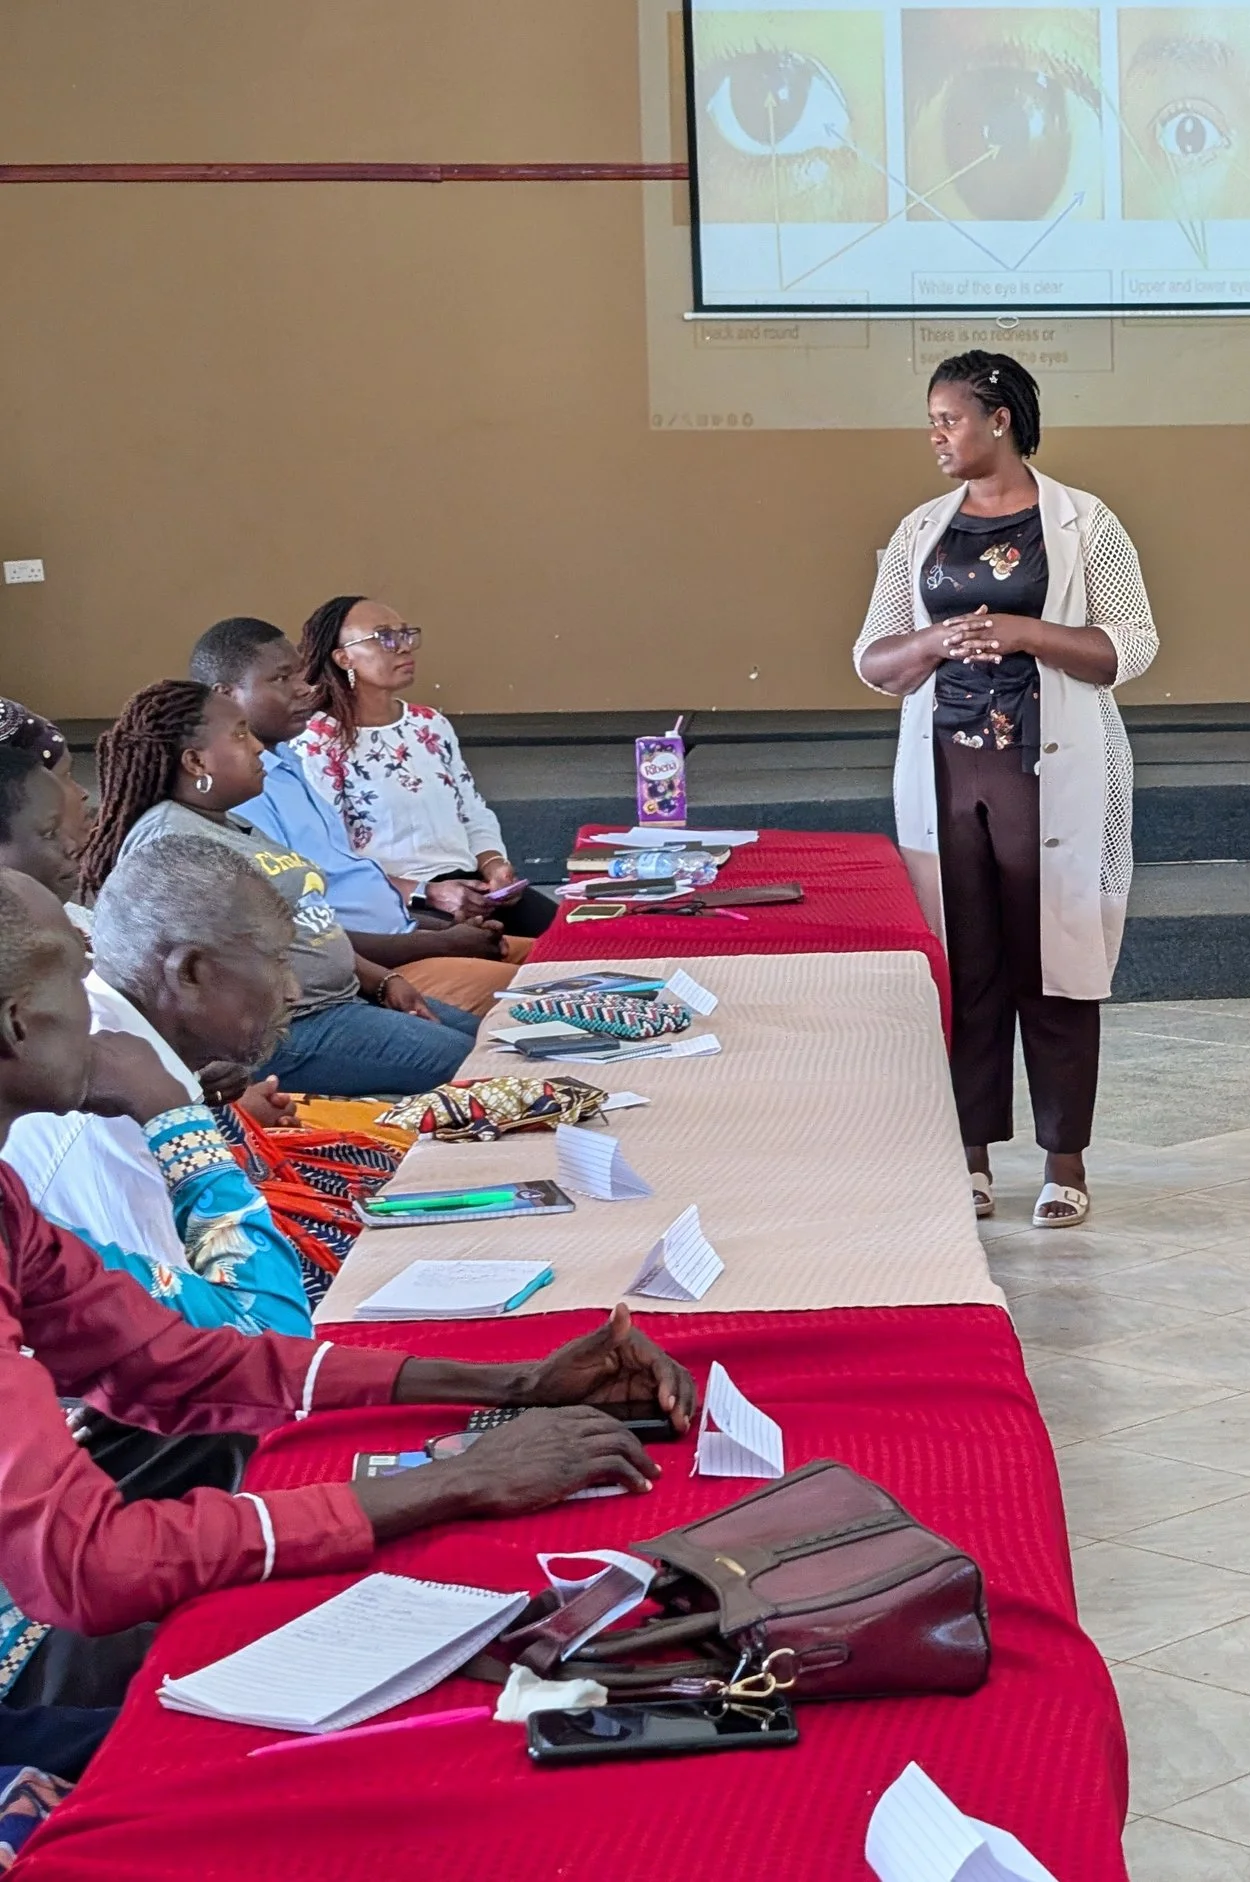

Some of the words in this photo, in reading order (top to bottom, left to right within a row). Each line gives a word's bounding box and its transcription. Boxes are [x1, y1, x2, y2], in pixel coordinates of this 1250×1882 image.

[918, 279, 954, 295] White
[957, 279, 969, 294] of
[972, 279, 991, 294] the
[994, 281, 1017, 298] eye
[1020, 279, 1030, 294] is
[1033, 279, 1063, 294] clear
[1129, 278, 1166, 295] Upper
[1168, 278, 1192, 293] and
[1195, 277, 1227, 293] lower
[737, 324, 762, 340] and
[764, 324, 800, 340] round
[920, 327, 956, 342] There
[958, 327, 970, 342] is
[972, 329, 988, 342] no
[990, 327, 1039, 342] redness
[1042, 328, 1056, 342] or
[1039, 350, 1069, 367] eyes
[645, 761, 677, 776] Ribena
